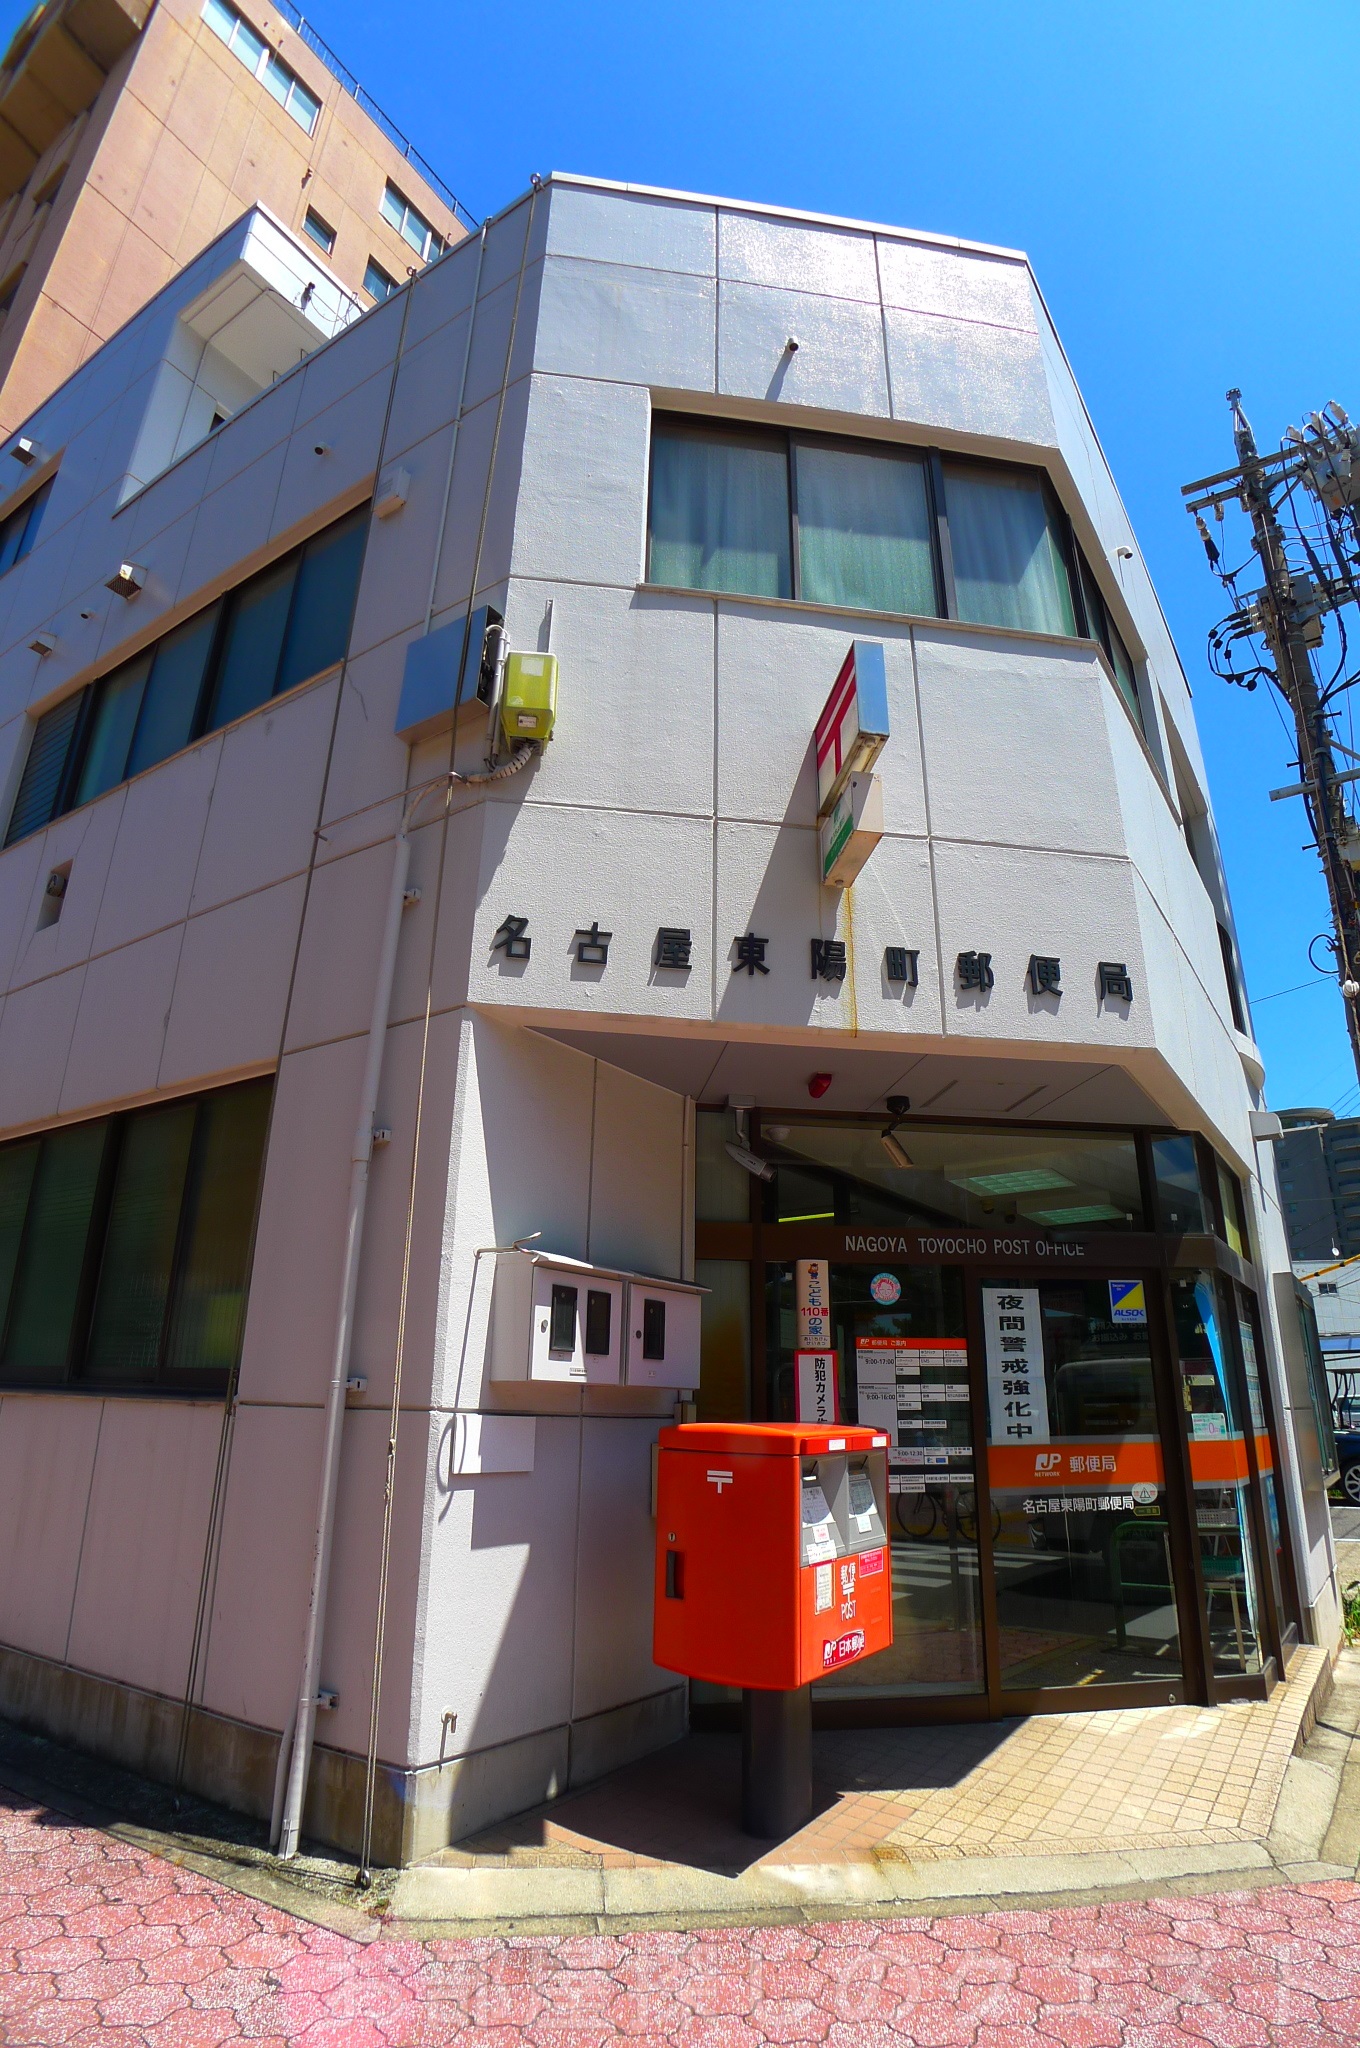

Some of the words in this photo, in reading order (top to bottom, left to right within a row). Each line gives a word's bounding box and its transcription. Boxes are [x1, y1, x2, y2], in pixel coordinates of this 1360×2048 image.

[495, 914, 1133, 1002] 名古屋東陽町郵便局
[845, 1235, 907, 1253] NAGOYA
[918, 1237, 987, 1254] TOYOCHO
[994, 1238, 1030, 1255] POST
[1113, 1309, 1145, 1317] ALSOK
[996, 1294, 1033, 1440] 夜間警戒強化中
[1069, 1455, 1117, 1473] 郵便局
[1022, 1496, 1135, 1514] 名古屋東陽町郵便局
[840, 1562, 857, 1584] 郵便
[840, 1600, 857, 1621] POST
